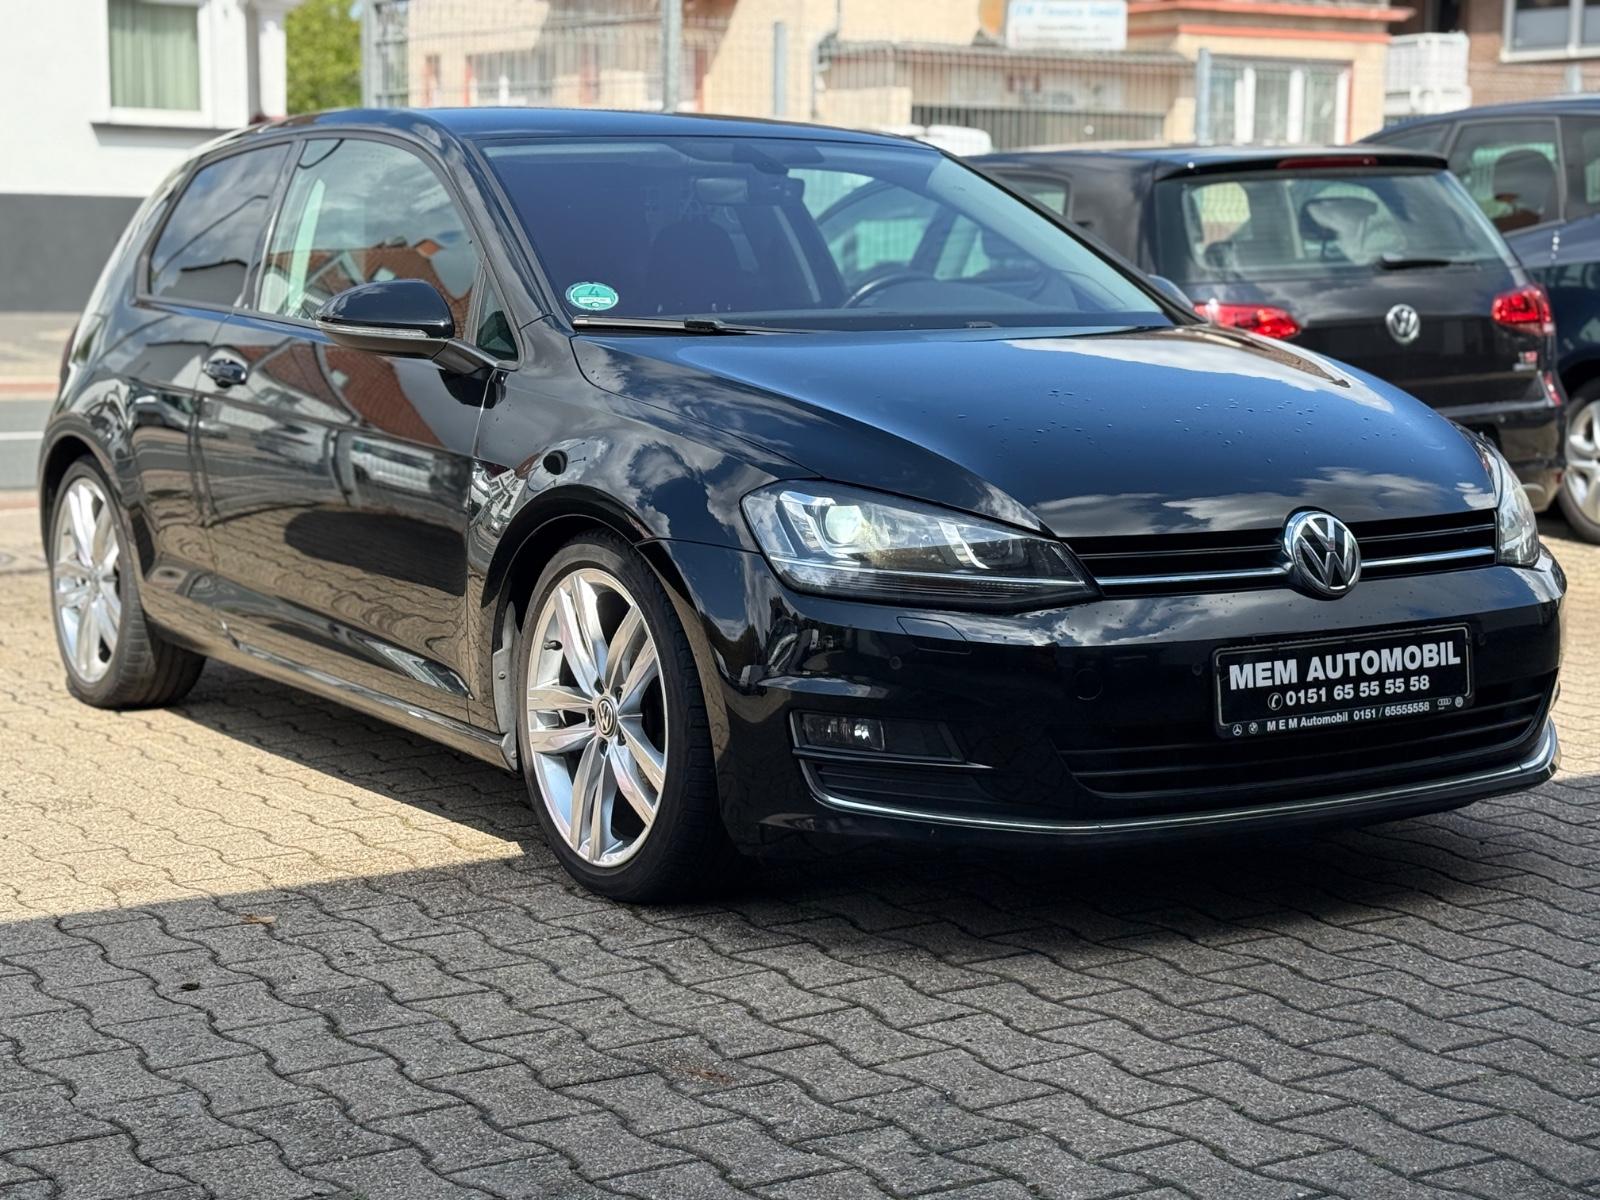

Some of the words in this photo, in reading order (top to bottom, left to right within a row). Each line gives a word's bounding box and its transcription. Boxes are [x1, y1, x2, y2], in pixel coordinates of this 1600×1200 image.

[588, 286, 600, 297] 4
[1385, 303, 1421, 344] VW
[1287, 513, 1360, 593] VW
[1229, 658, 1298, 690] MEM
[1306, 641, 1461, 682] AUTOMOBIL
[1286, 687, 1327, 706] 0151
[1333, 683, 1354, 701] 65
[1359, 680, 1380, 697] 55
[1384, 677, 1405, 694] 55
[1409, 675, 1430, 691] 58
[1300, 711, 1348, 727] Automobil
[1353, 708, 1376, 720] 0151
[1385, 701, 1430, 716] 65555558
